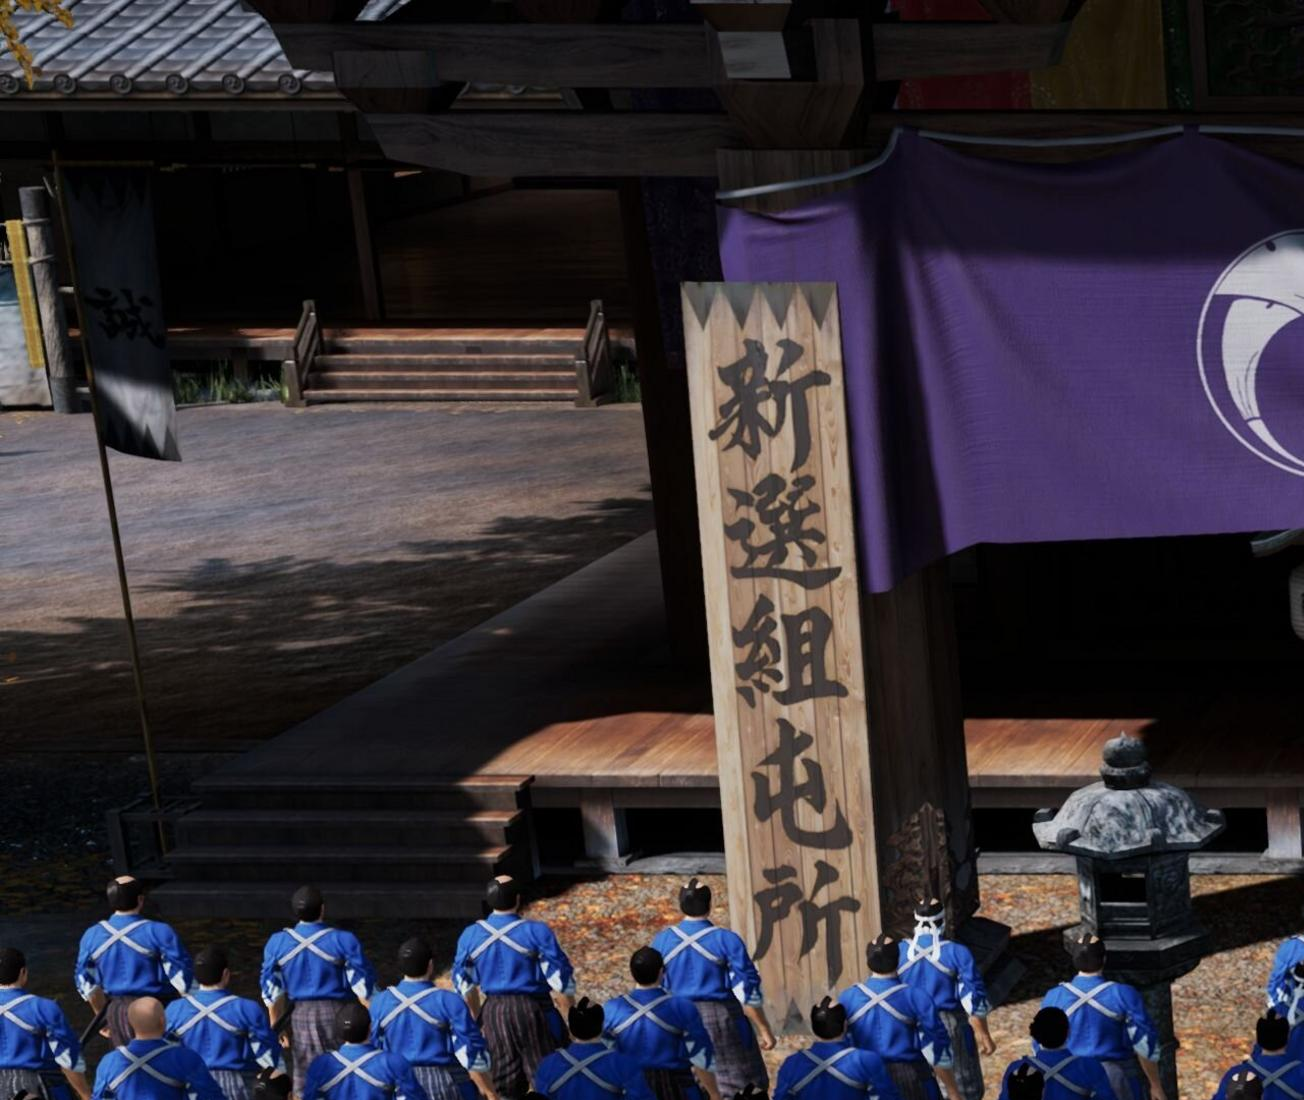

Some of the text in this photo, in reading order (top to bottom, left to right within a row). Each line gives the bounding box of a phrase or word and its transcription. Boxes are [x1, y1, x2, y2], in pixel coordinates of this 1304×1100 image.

[708, 338, 861, 988] 新選組屯所
